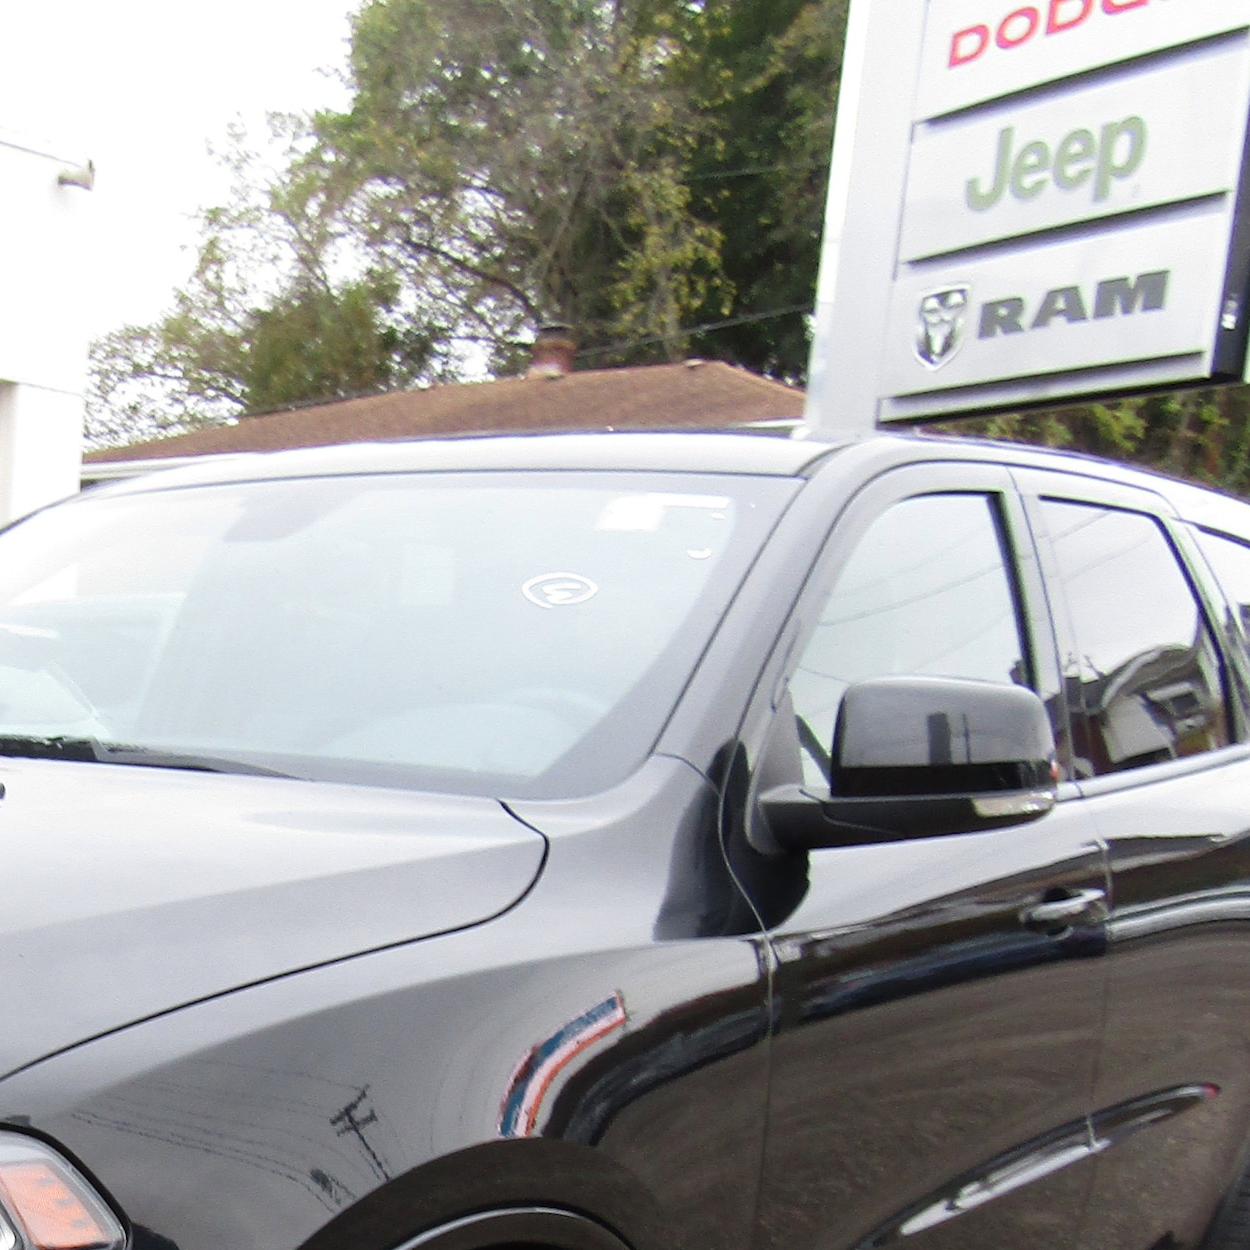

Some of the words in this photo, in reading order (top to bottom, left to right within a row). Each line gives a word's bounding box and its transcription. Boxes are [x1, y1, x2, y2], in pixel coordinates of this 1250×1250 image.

[949, 0, 1164, 68] DOD
[965, 116, 1147, 211] Jeep
[977, 270, 1170, 340] RAM
